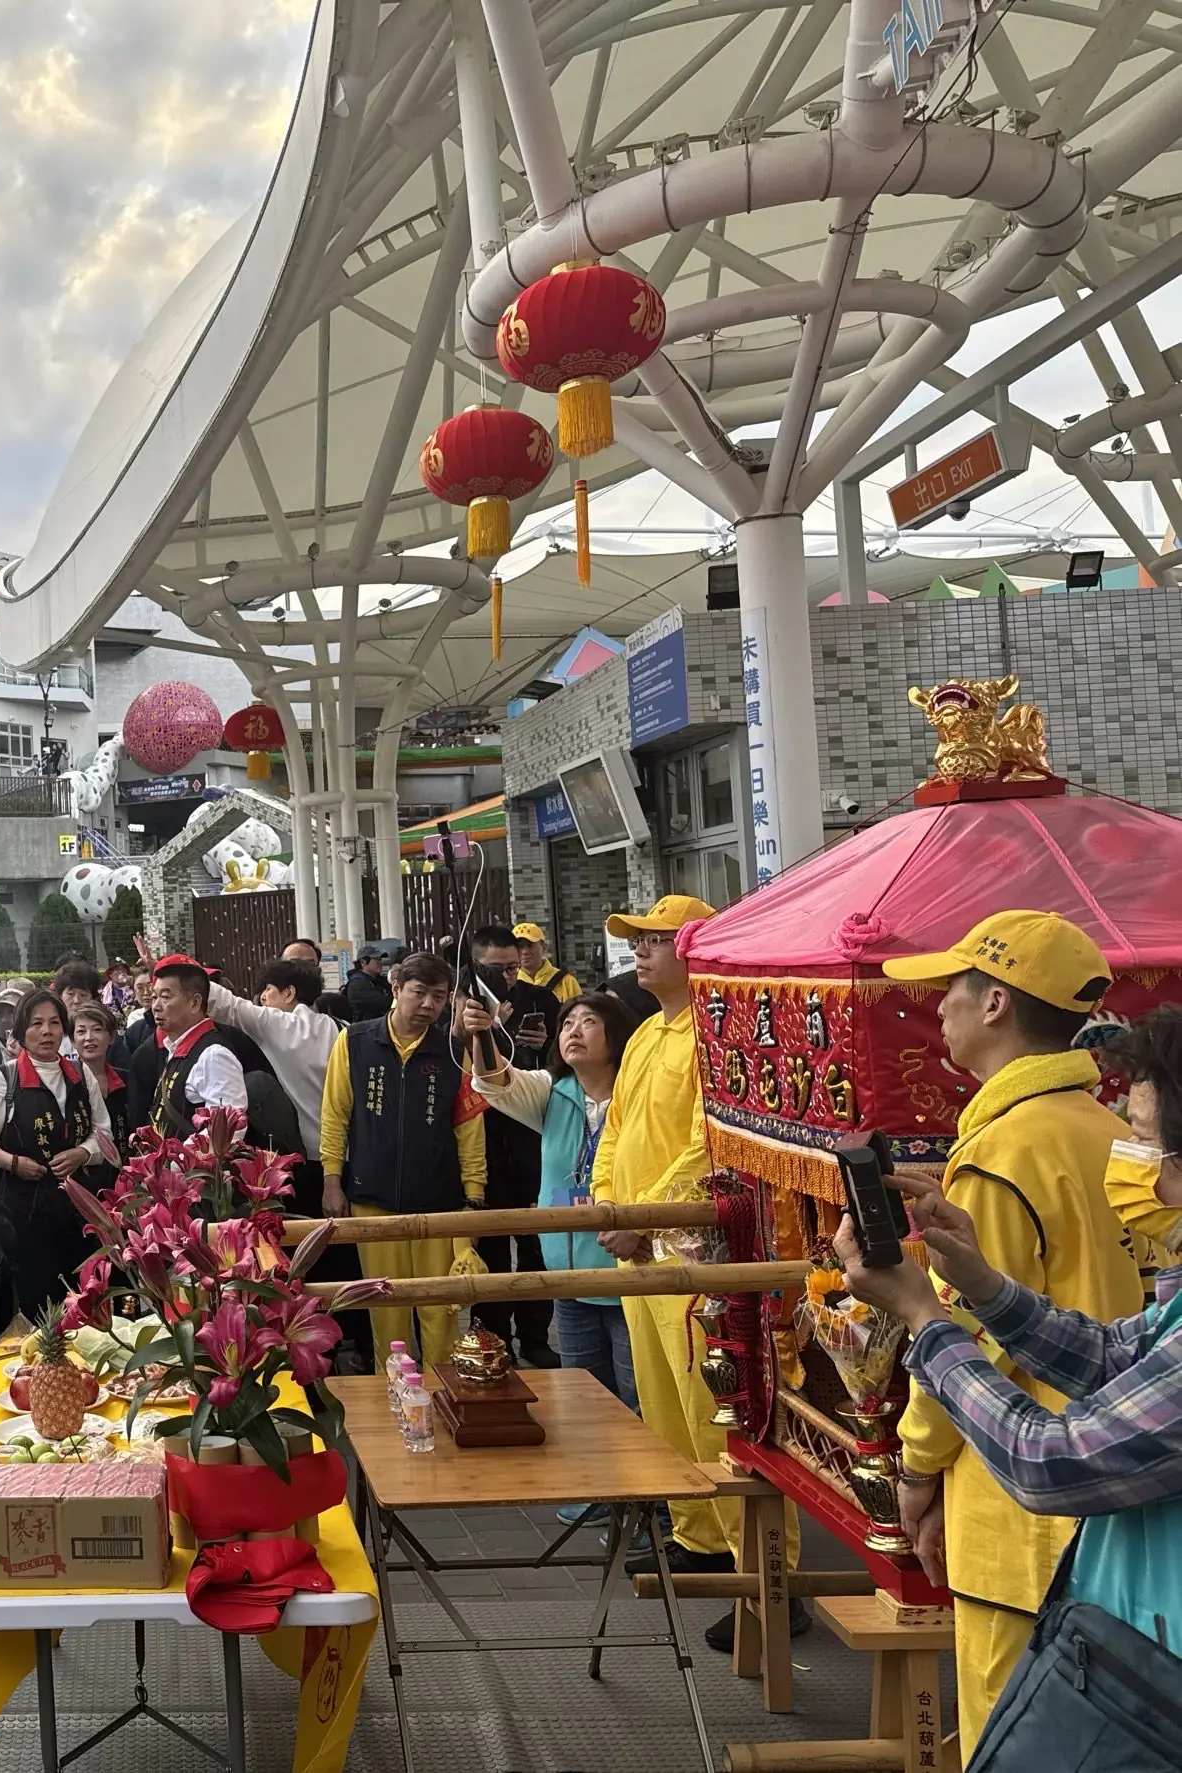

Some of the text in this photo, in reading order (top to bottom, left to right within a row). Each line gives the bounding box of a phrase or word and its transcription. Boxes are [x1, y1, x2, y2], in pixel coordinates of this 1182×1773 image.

[883, 0, 943, 95] TAI
[913, 457, 975, 511] 出口 EXIT
[743, 636, 777, 890] 未購買一日樂un
[61, 842, 75, 852] 1F
[11, 1555, 54, 1573] BLACK TEA
[768, 1528, 784, 1604] 台北葫蘆寺
[916, 1690, 936, 1773] 台北葫蘆
